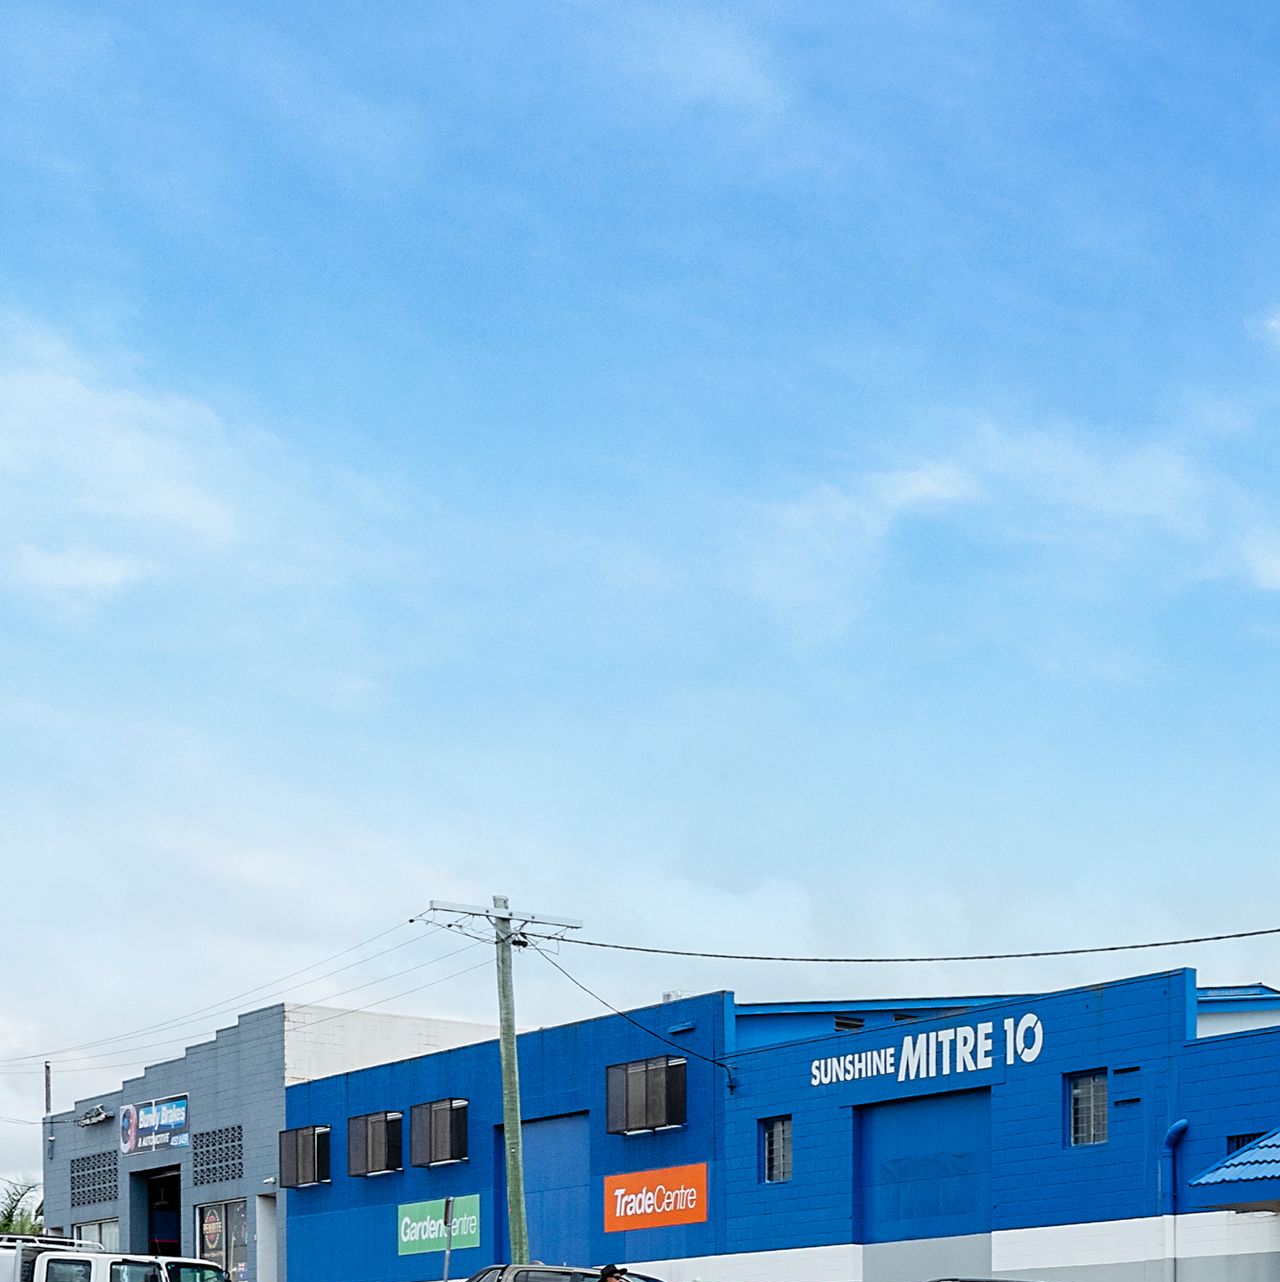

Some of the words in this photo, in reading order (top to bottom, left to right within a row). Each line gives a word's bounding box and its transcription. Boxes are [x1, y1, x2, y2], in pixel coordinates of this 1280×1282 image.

[811, 1047, 896, 1087] SUNSHINE
[897, 1021, 994, 1083] MITRE
[1003, 1012, 1044, 1064] 10
[613, 1184, 697, 1217] TradeCentre
